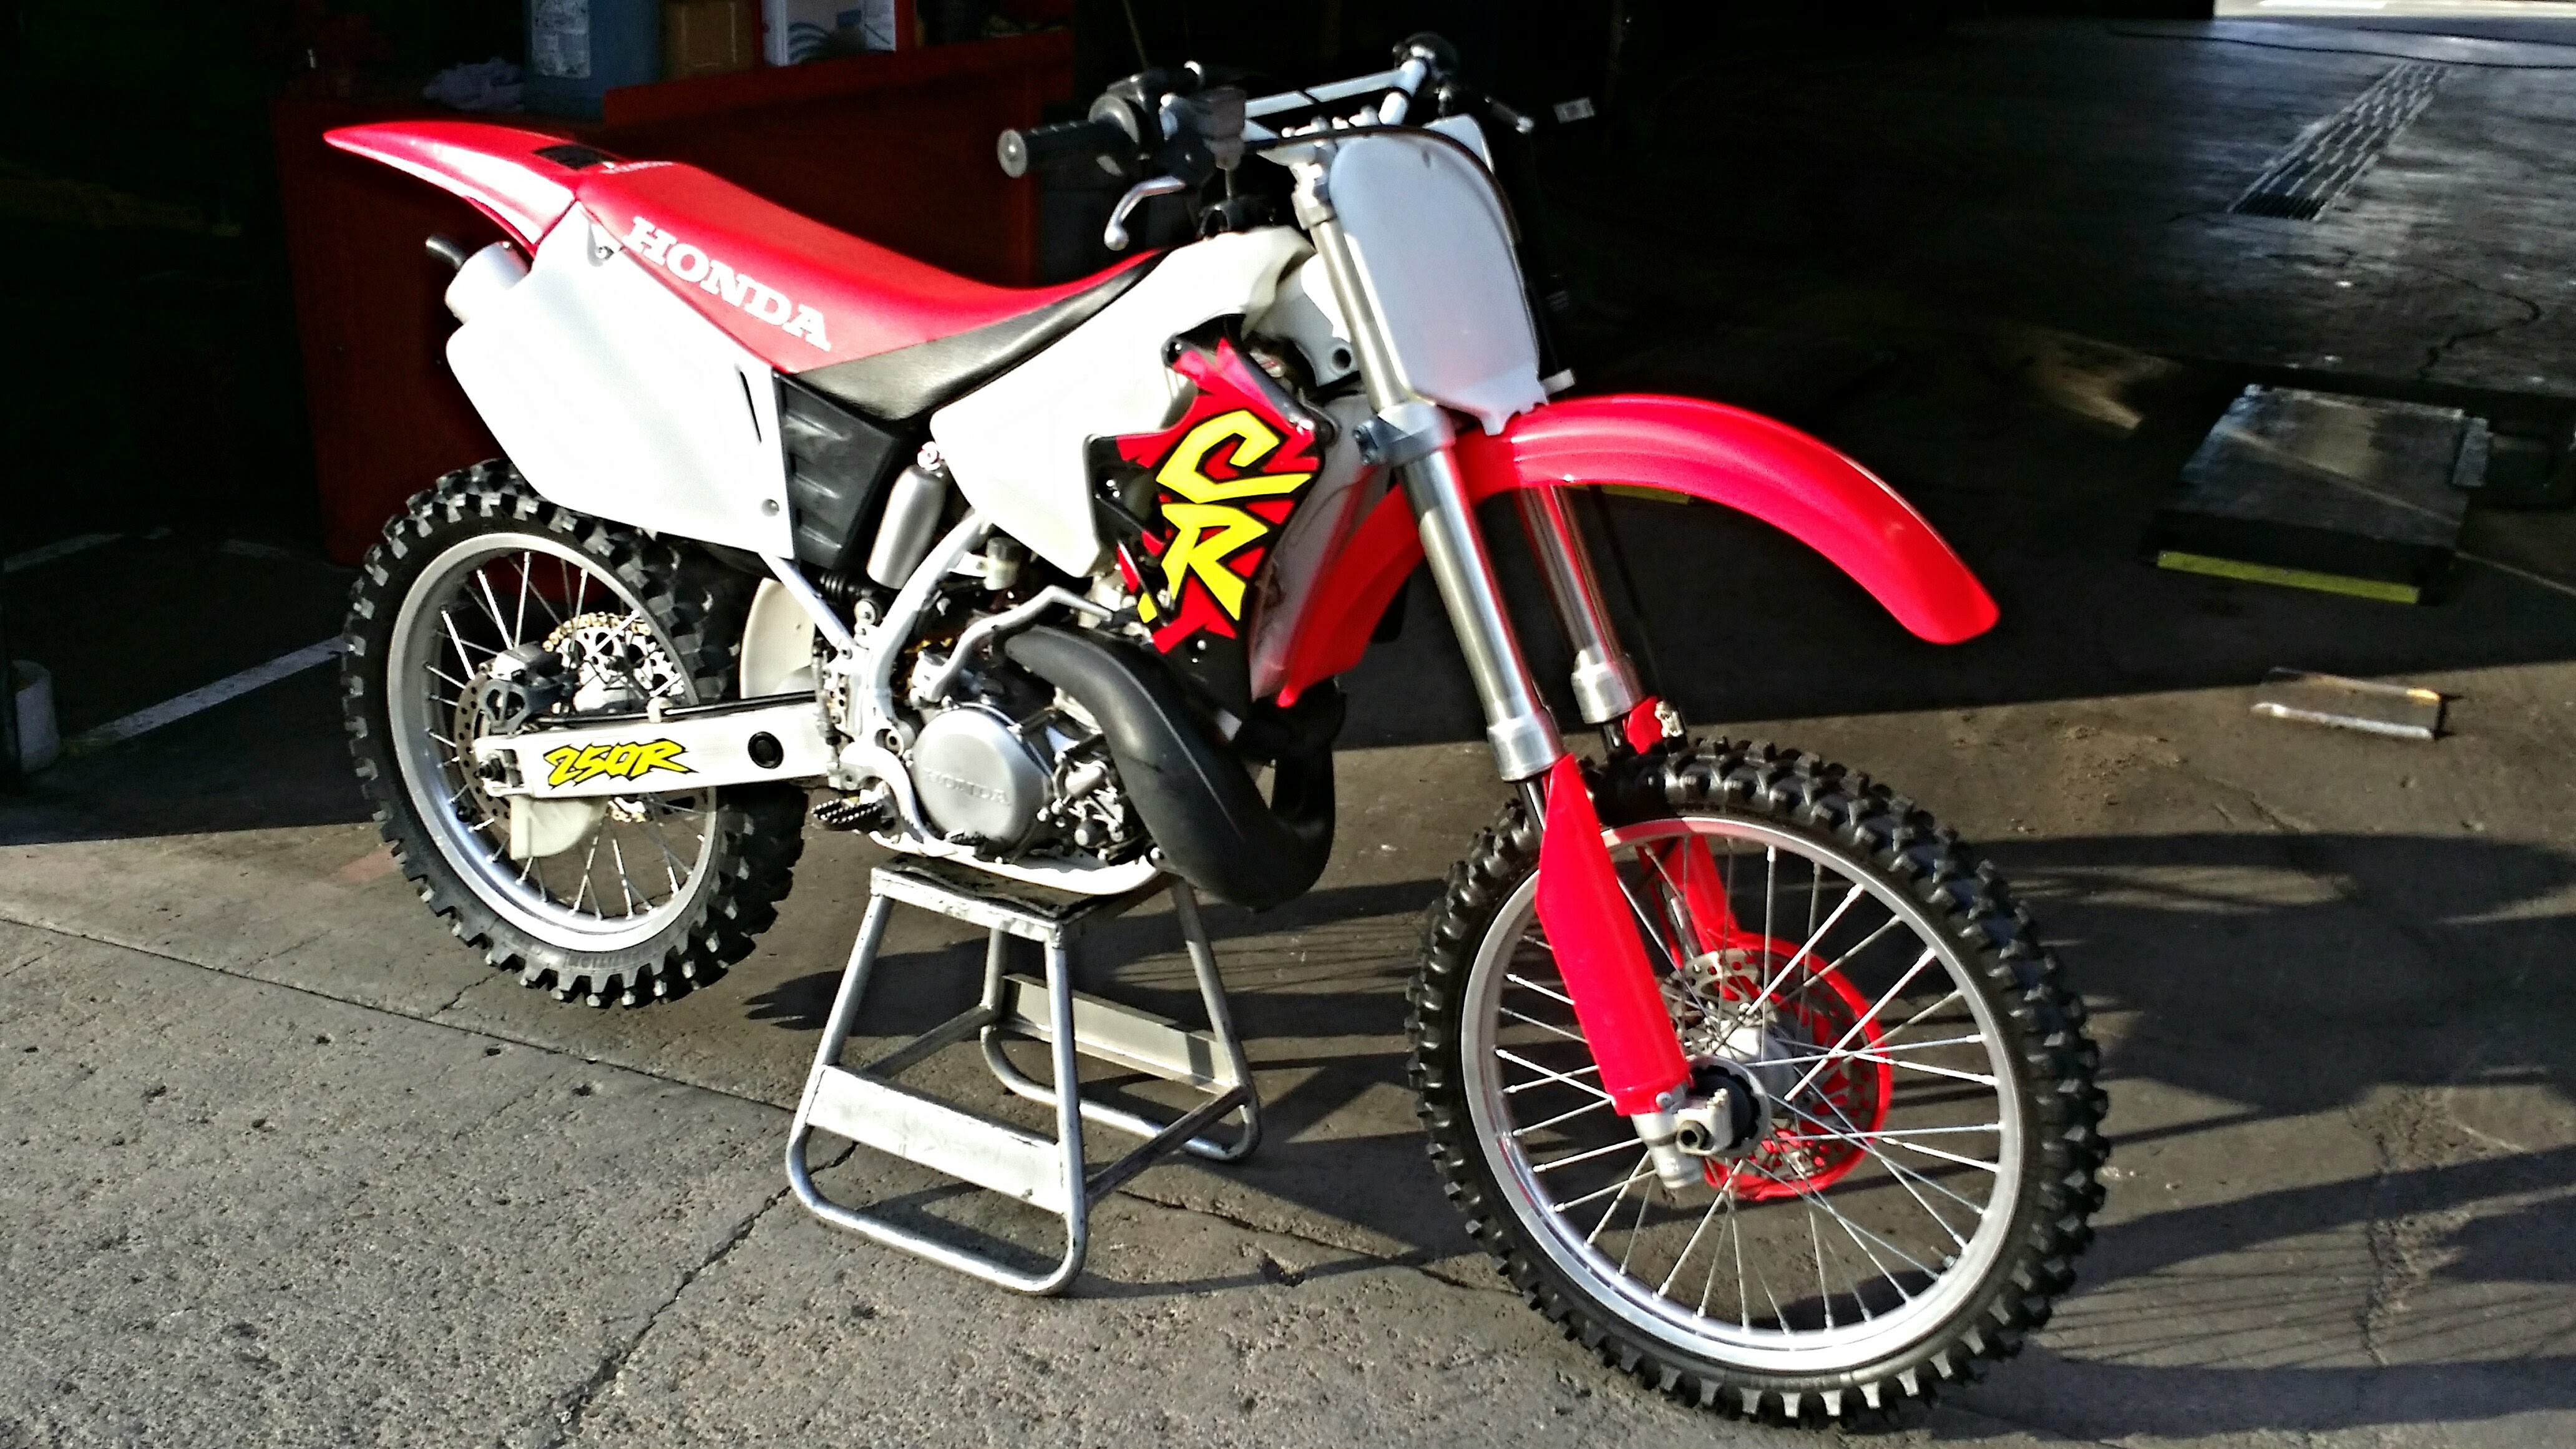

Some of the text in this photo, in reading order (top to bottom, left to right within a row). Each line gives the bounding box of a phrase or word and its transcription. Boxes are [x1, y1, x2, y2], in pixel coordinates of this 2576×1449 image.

[625, 216, 831, 352] HONDA
[1156, 409, 1312, 621] CR
[543, 738, 696, 789] 250R
[923, 767, 1011, 806] HONDA
